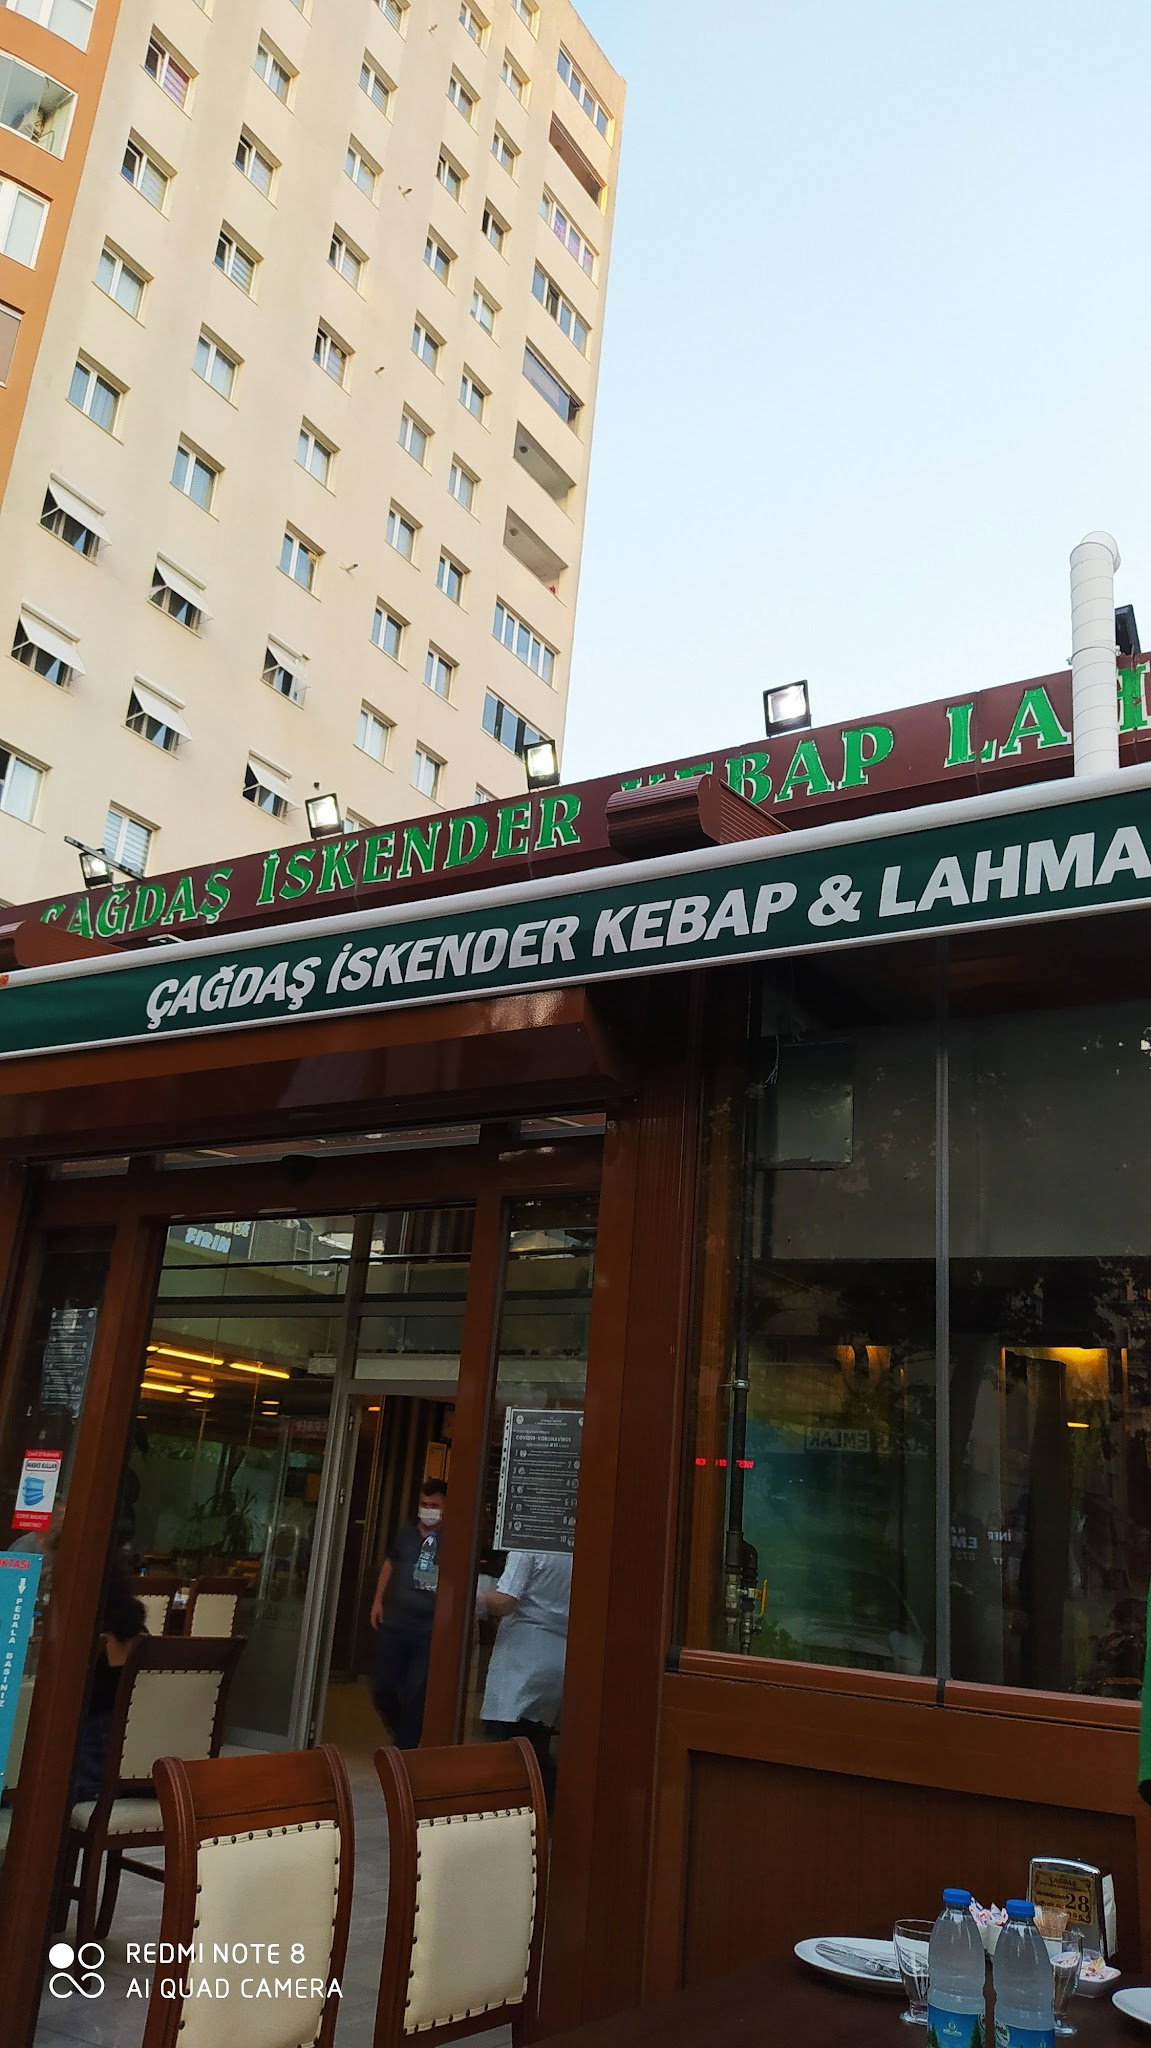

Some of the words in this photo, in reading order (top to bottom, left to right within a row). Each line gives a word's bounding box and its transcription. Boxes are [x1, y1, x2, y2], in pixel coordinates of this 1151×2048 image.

[255, 792, 582, 906] İSKENDER
[620, 725, 895, 805] BAP
[145, 957, 323, 1030] ÇAĞDAŞ
[325, 915, 578, 995] İSKENDER
[591, 881, 798, 957] KEBAP
[807, 873, 863, 927] &
[878, 825, 1151, 919] LAHMA
[8, 1597, 24, 1644] PEDALA
[1065, 1892, 1090, 1913] 28
